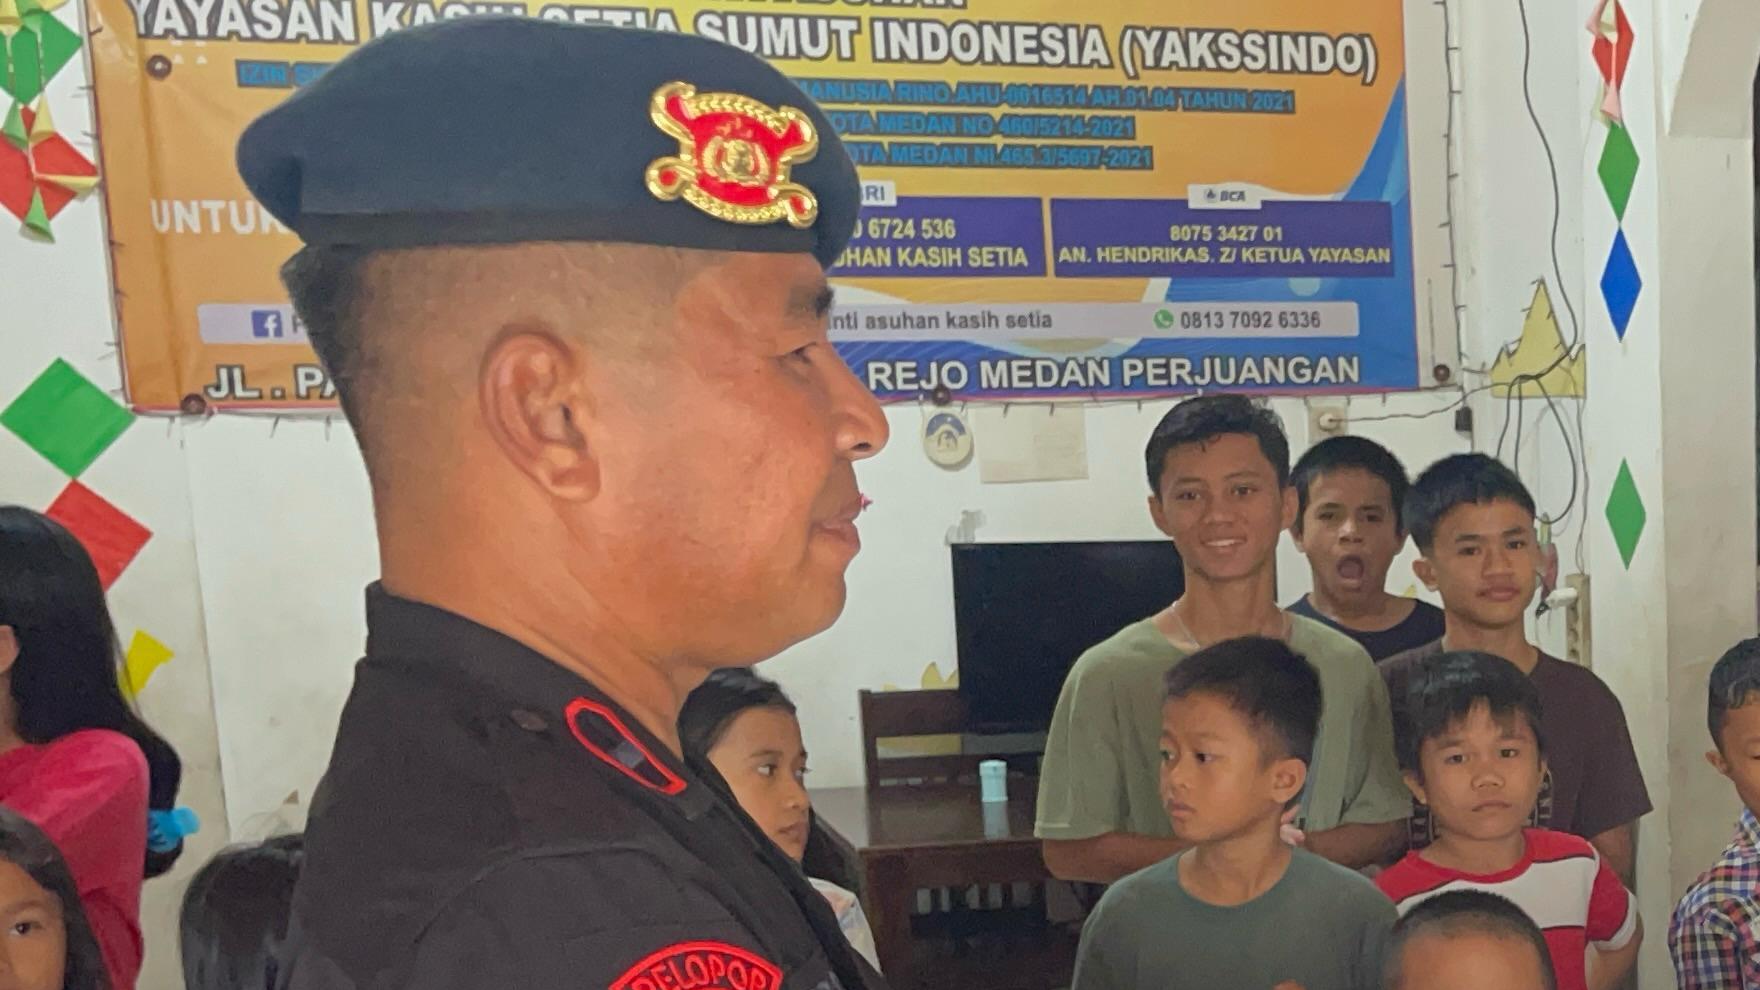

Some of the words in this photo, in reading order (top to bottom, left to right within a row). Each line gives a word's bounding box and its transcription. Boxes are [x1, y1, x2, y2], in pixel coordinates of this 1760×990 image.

[129, 0, 357, 42] YAYASAN
[696, 13, 859, 58] SUMUT
[872, 20, 1110, 66] INDONESIA
[1121, 27, 1376, 85] (YAKSSINDO)
[1180, 89, 1248, 110] TAHUN
[1252, 91, 1294, 112] 2021
[829, 112, 875, 133] OTA
[877, 113, 956, 134] MEDAN
[962, 115, 994, 135] NO
[848, 142, 888, 163] OTA
[892, 143, 968, 164] MEDAN
[861, 185, 885, 201] RI
[1219, 190, 1246, 202] BCA
[868, 218, 915, 239] 6724
[921, 218, 956, 239] 536
[1170, 225, 1212, 242] 8075
[1217, 225, 1257, 242] 3427
[1263, 226, 1283, 243] 01
[897, 246, 962, 267] KASIH
[967, 246, 1029, 268] SETIA
[1058, 248, 1092, 263] AN.
[1241, 247, 1305, 264] KETUA
[1308, 248, 1391, 264] YAYASAN
[830, 311, 858, 330] nti
[865, 311, 940, 330] asuhan
[946, 311, 999, 330] kasih
[1005, 311, 1053, 329] setia
[1180, 311, 1224, 329] 0813
[1230, 311, 1273, 329] 7092
[1278, 311, 1322, 328] 6336
[867, 360, 968, 391] REJO
[980, 357, 1110, 389] MEDAN
[1122, 356, 1359, 387] PERJUANGAN
